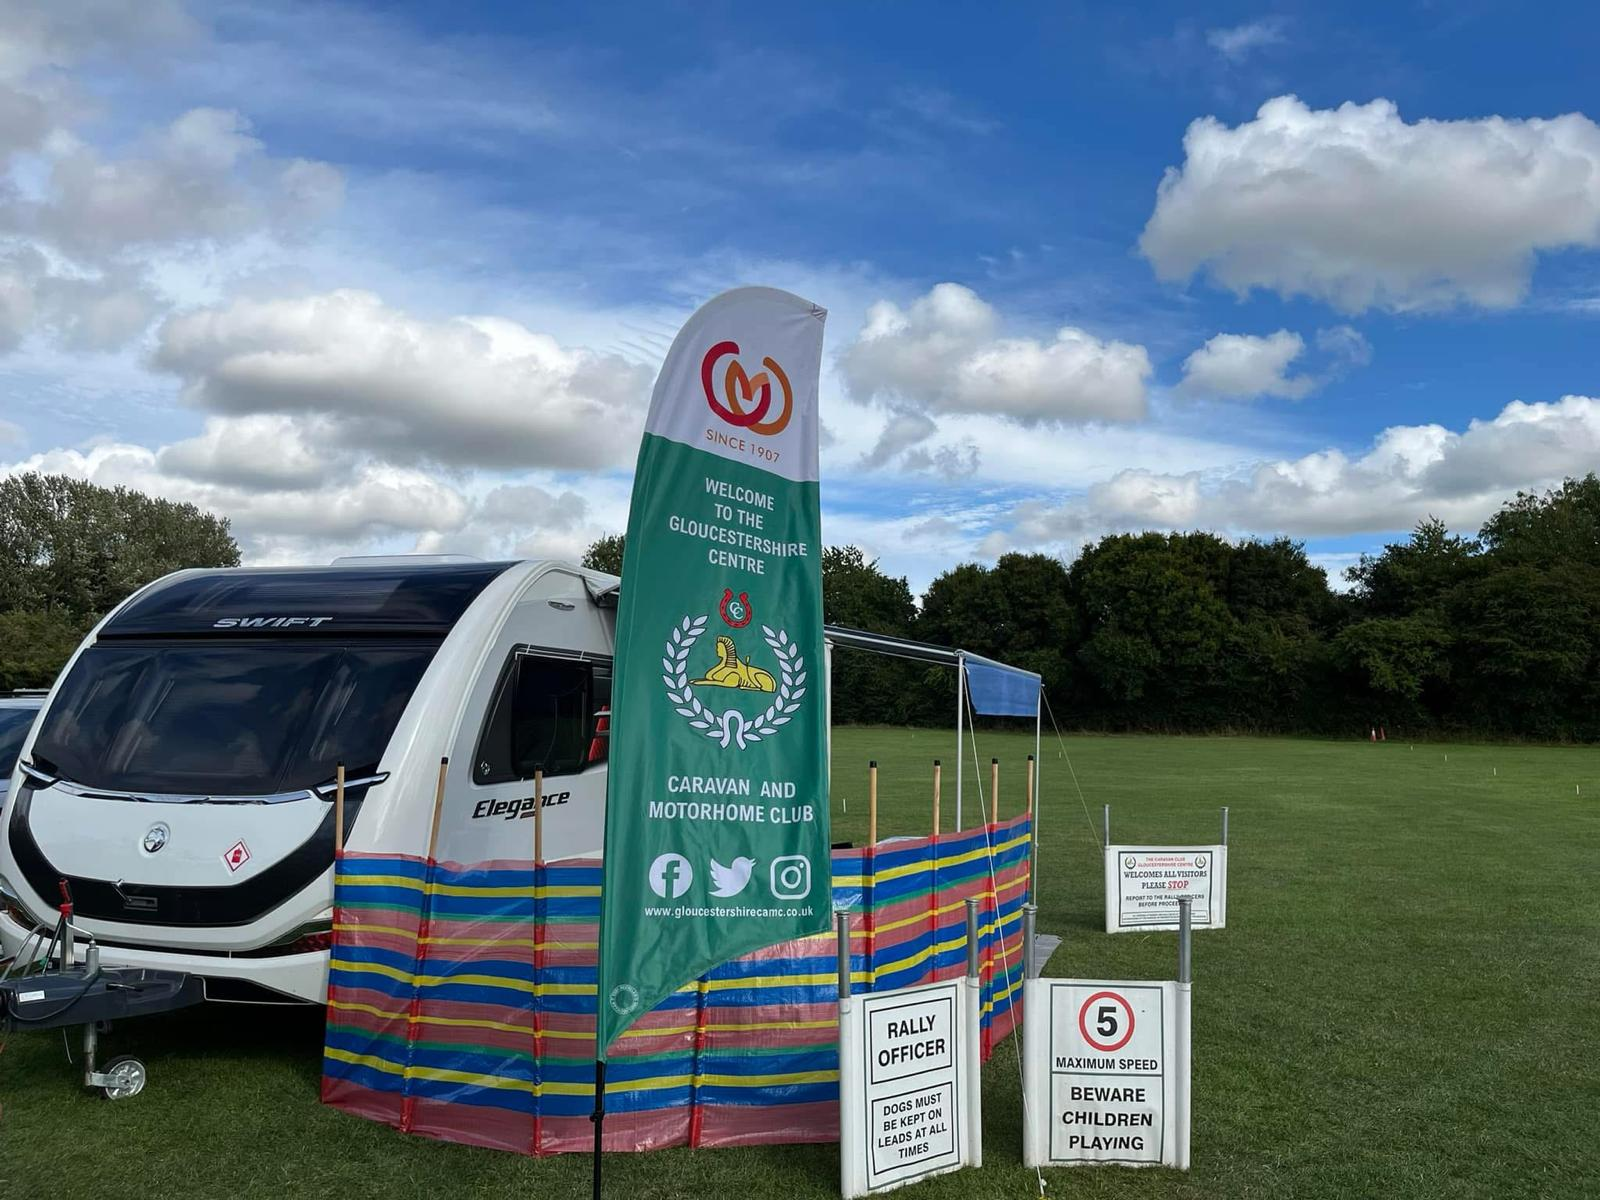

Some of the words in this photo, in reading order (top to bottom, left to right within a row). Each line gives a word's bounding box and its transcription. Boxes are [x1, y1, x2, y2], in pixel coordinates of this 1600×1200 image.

[706, 429, 746, 451] SINCE
[751, 443, 780, 463] 1907
[705, 477, 774, 511] WELCOME
[714, 503, 733, 521] TO
[737, 509, 764, 530] THE
[669, 515, 808, 557] GLOUCESTERSHIRE
[708, 549, 765, 575] CENTRE
[213, 617, 333, 628] SWIFT
[667, 775, 750, 796] CARAVAN
[760, 781, 796, 798] AND
[648, 801, 765, 822] MOTORHOME
[770, 805, 814, 824] CLUB
[1142, 881, 1166, 889] PLEASE
[1168, 880, 1189, 889] STOP
[1177, 870, 1207, 878] VISITORS
[644, 905, 814, 919] www.gloucestershirecamc.co.uk
[887, 1015, 936, 1039] RALLY
[1096, 1006, 1118, 1037] 5
[878, 1038, 945, 1067] OFFICER
[1056, 1057, 1115, 1070] MAXIMUM
[1119, 1058, 1158, 1071] SPEED
[883, 1099, 912, 1116] DOGS
[915, 1093, 942, 1108] MUST
[1071, 1086, 1146, 1102] BEWARE
[883, 1118, 897, 1132] BE
[900, 1114, 926, 1128] KEPT
[928, 1108, 942, 1120] ON
[1062, 1111, 1153, 1127] CHILDREN
[878, 1131, 913, 1148] LEADS
[915, 1127, 927, 1139] AT
[929, 1122, 947, 1134] ALL
[1069, 1135, 1144, 1150] PLAYING
[898, 1142, 929, 1159] TIMES
